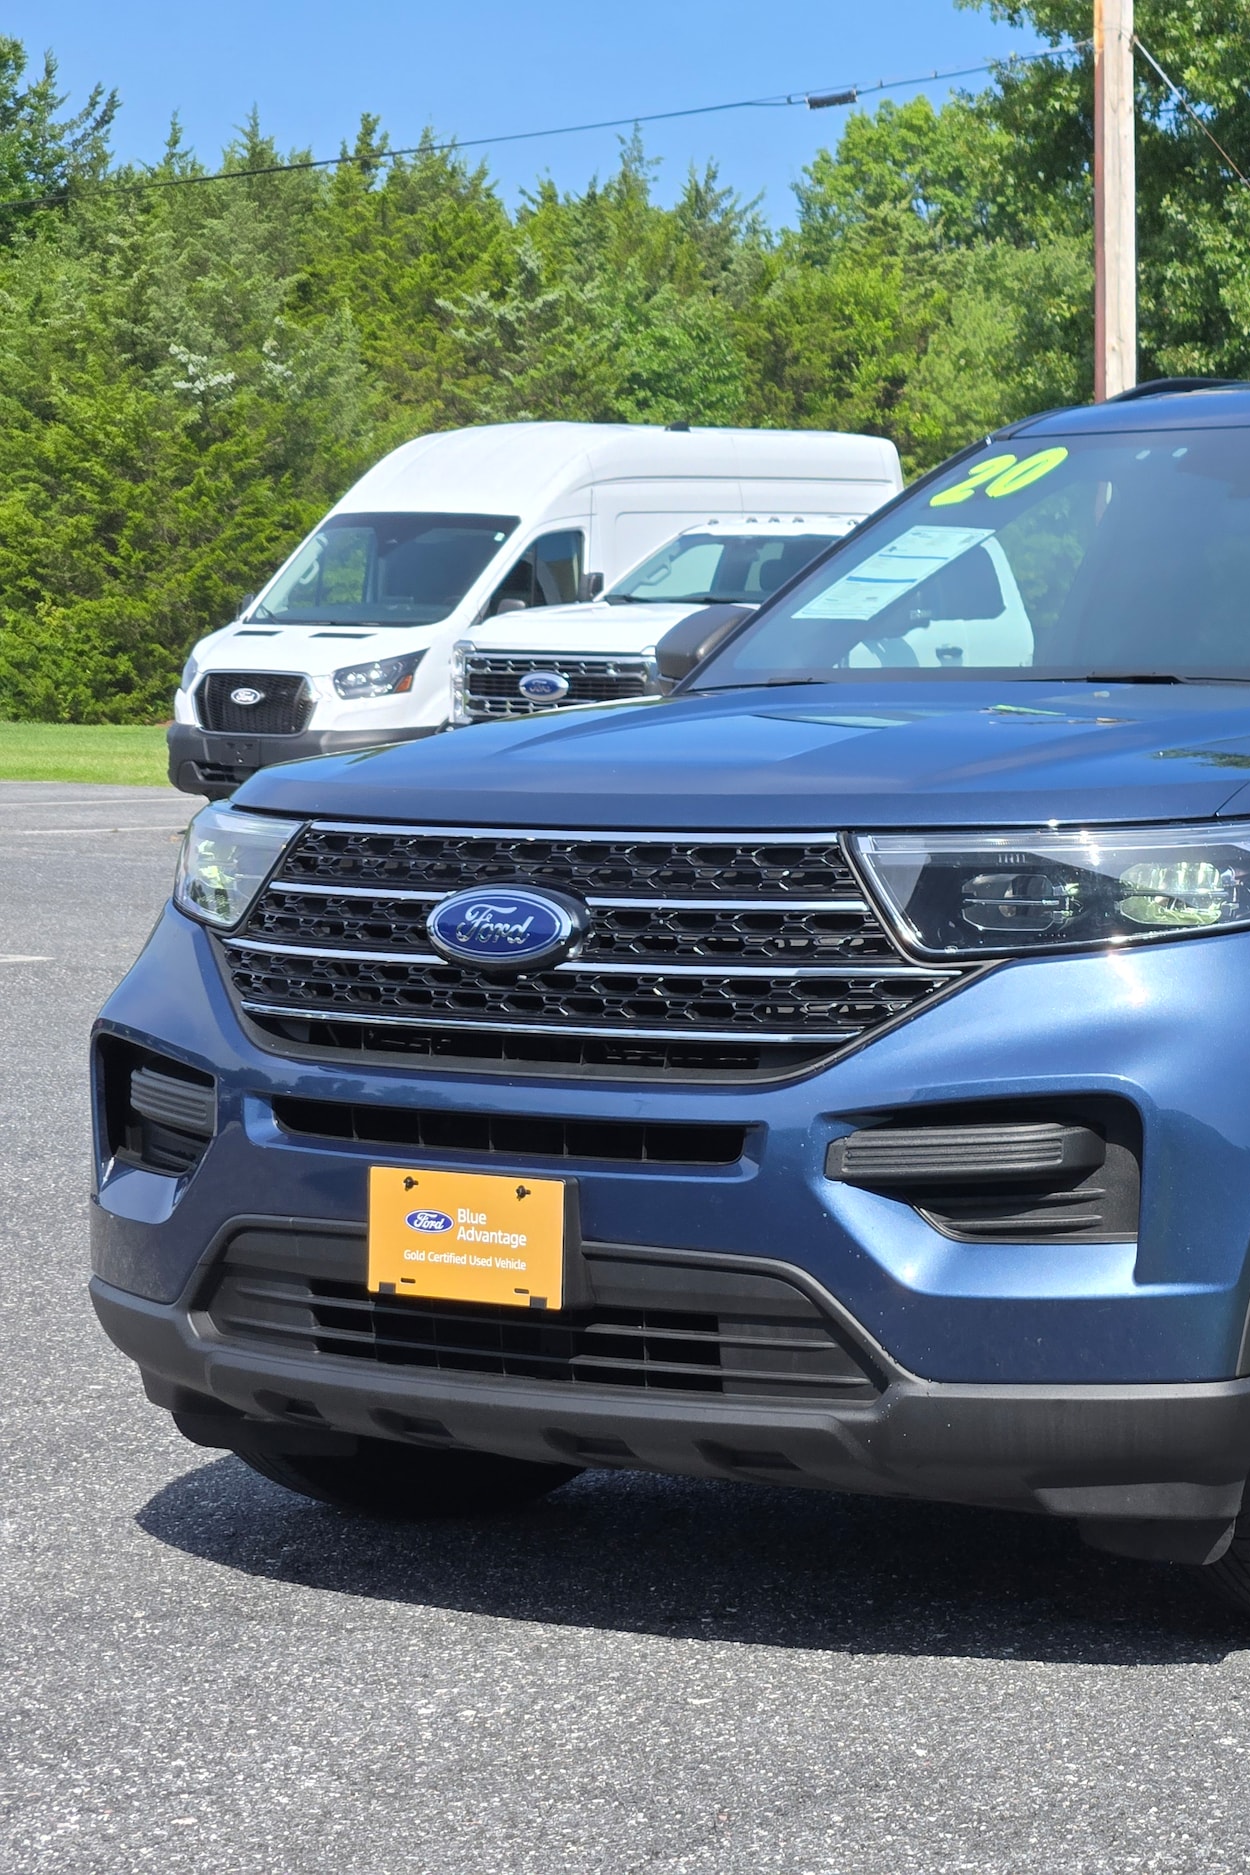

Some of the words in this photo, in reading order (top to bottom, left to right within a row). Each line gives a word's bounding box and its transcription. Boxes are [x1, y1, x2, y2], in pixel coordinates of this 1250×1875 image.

[929, 446, 1069, 508] 20
[456, 903, 535, 944] Ford
[414, 1212, 444, 1230] Ford
[457, 1208, 487, 1225] Blue
[457, 1226, 527, 1248] Advantage
[403, 1249, 426, 1262] Gold
[427, 1251, 467, 1265] Certified
[469, 1255, 492, 1268] Used
[494, 1257, 527, 1271] Vehicle
